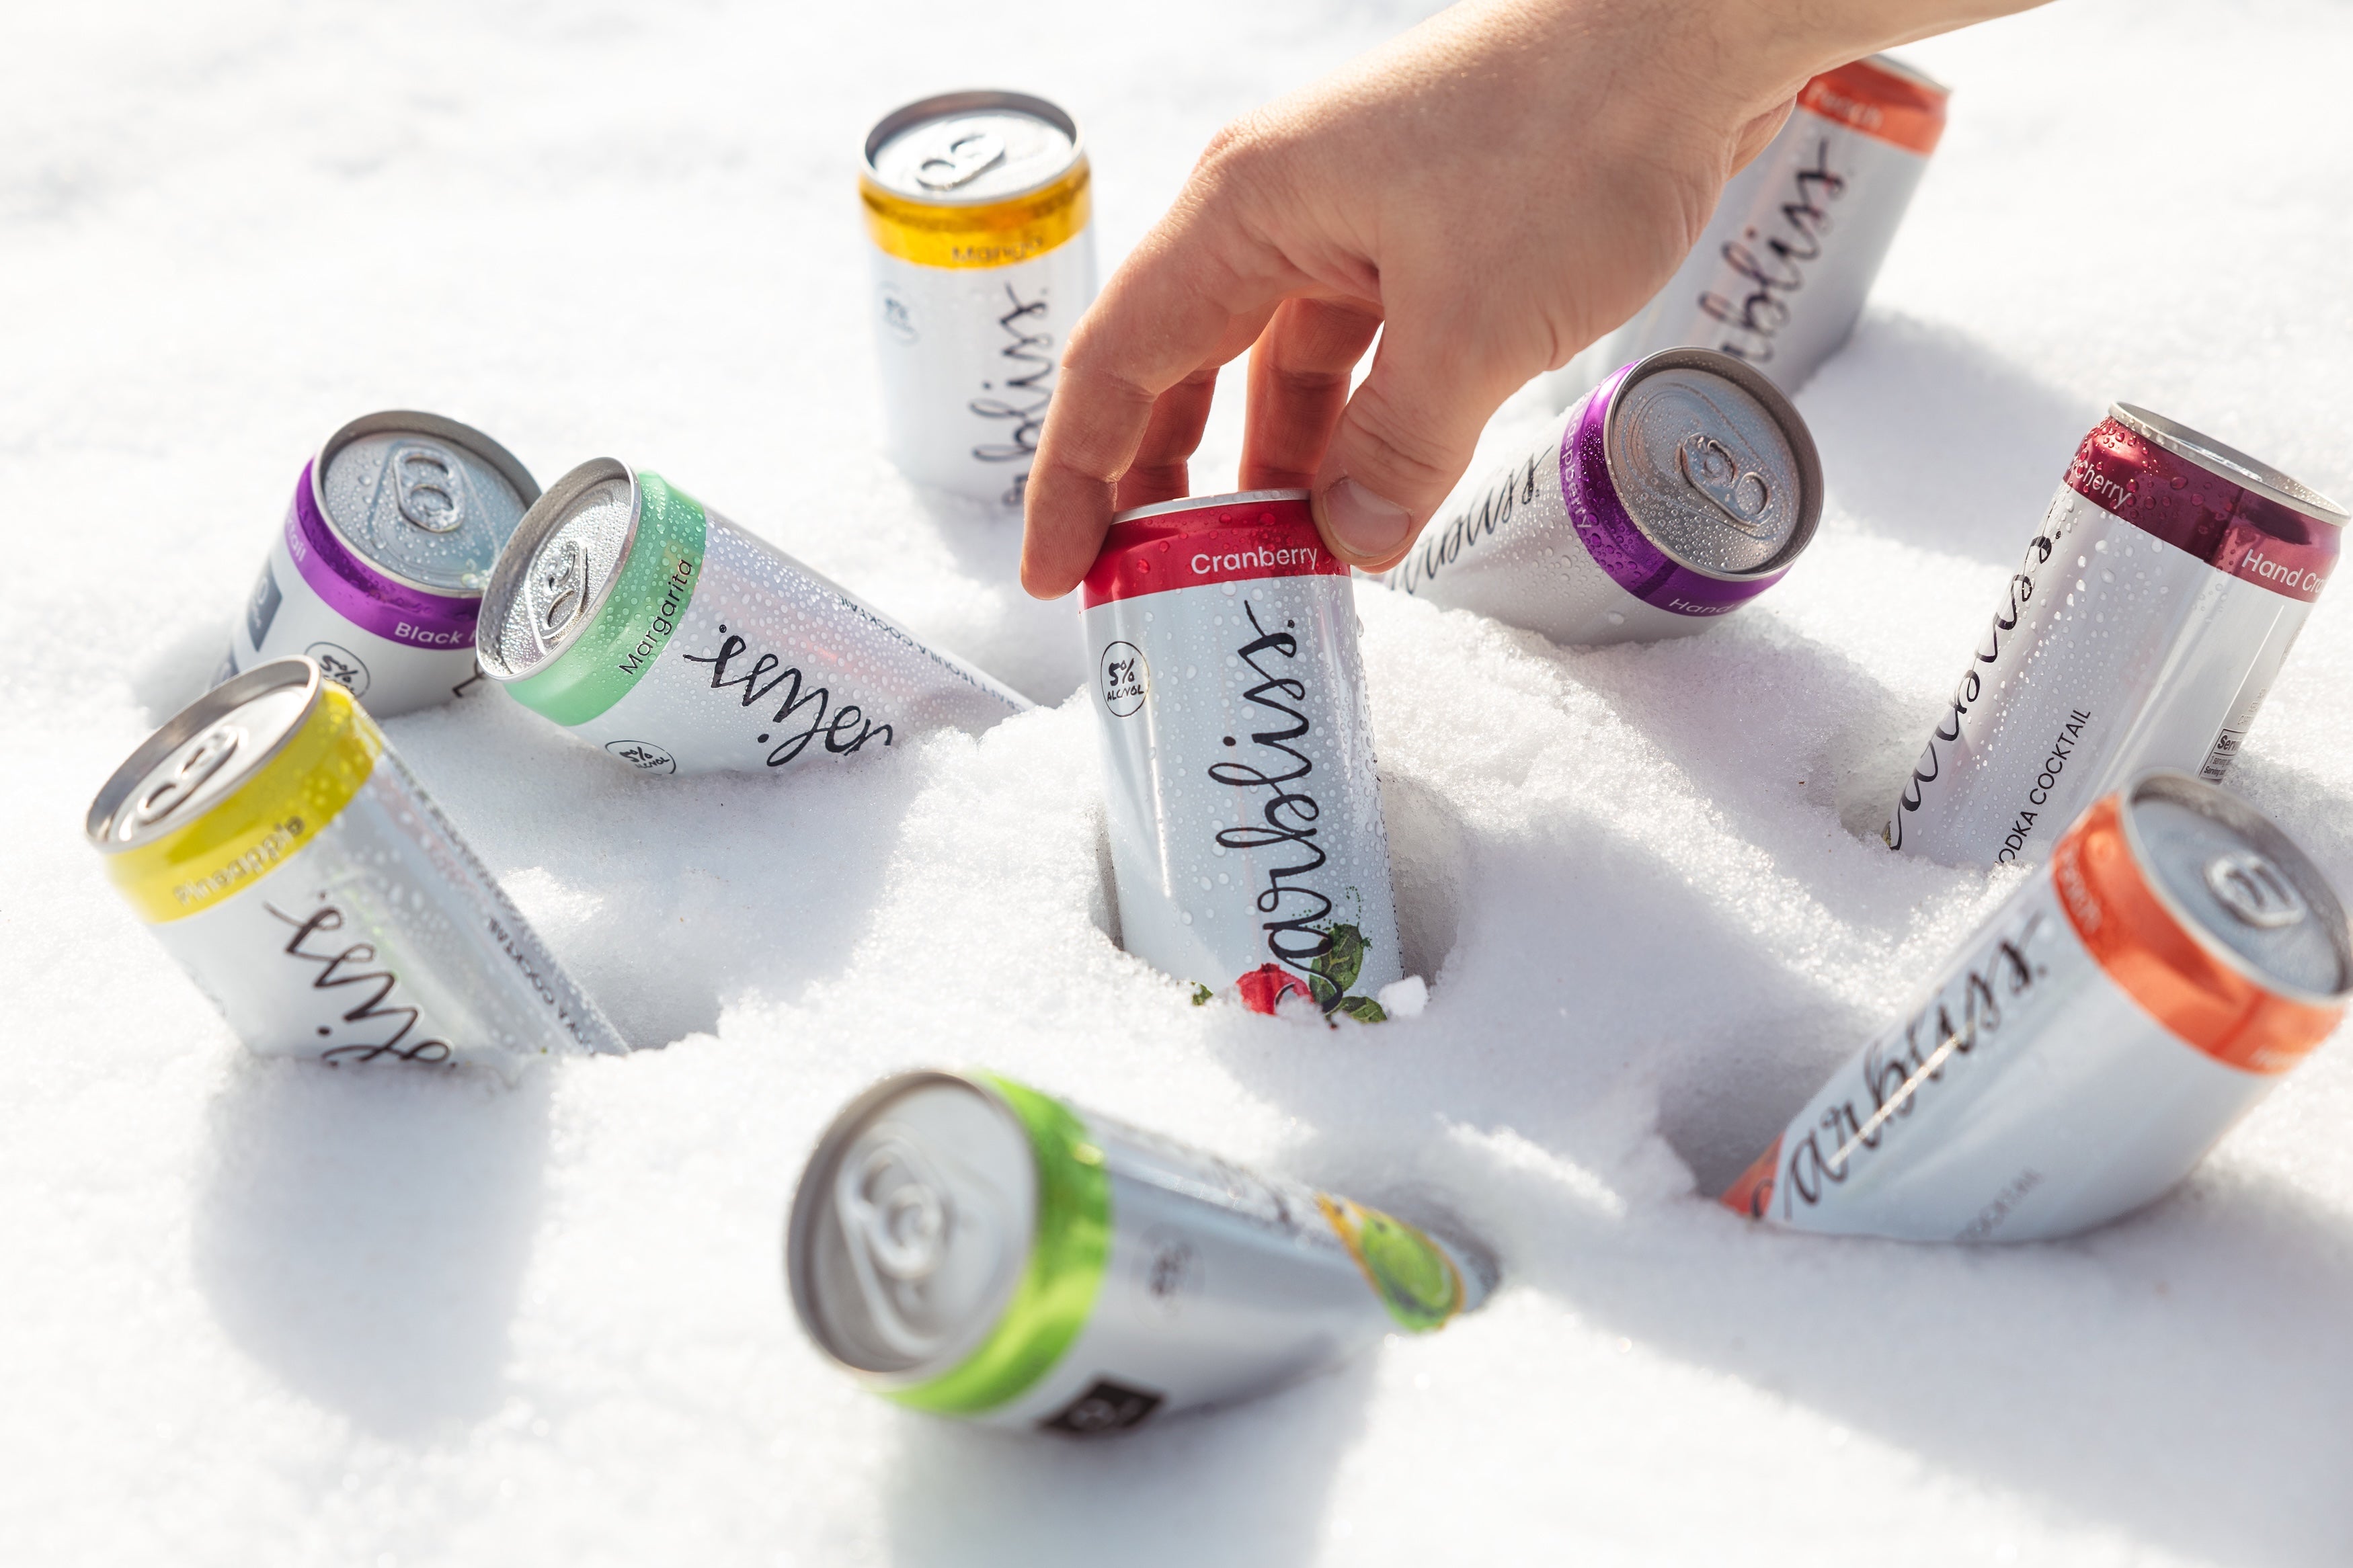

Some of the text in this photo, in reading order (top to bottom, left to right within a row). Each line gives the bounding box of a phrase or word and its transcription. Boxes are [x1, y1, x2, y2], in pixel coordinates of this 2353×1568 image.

[951, 235, 1043, 265] Mango
[2075, 460, 2132, 511] Cherry
[1191, 545, 1318, 576] Cranberry
[2241, 548, 2305, 587] Hand
[619, 558, 694, 676] Margarita
[836, 592, 914, 647] COCKTAIL
[1669, 598, 1736, 614] Hand
[394, 621, 464, 645] Black
[319, 655, 358, 683] 5%
[916, 642, 978, 687] TEQUILA
[1108, 657, 1135, 686] 5%
[619, 746, 653, 763] 5%
[1995, 709, 2091, 864] ODKA COCKTAIL
[173, 815, 305, 907] Pineapple
